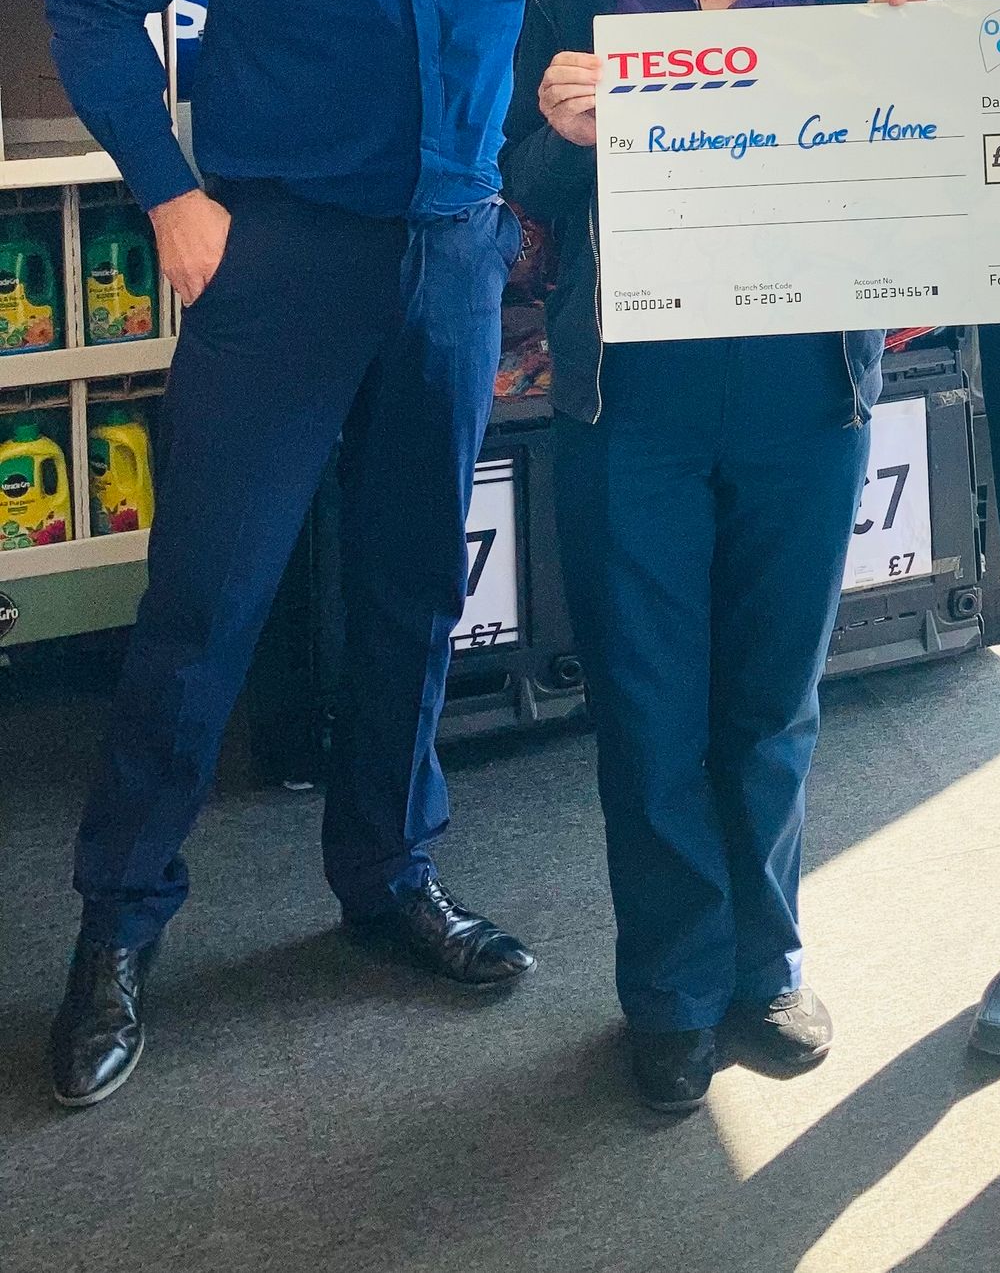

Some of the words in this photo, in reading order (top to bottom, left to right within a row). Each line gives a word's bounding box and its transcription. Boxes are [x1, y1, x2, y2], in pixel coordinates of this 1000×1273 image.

[608, 46, 758, 79] TESCO
[610, 136, 634, 151] Pay
[649, 125, 779, 160] Rutherglen
[797, 114, 849, 150] Care
[868, 104, 938, 144] Home
[734, 283, 758, 291] Branch
[759, 282, 774, 291] Sort
[774, 282, 793, 290] Code
[854, 278, 882, 286] Account
[614, 290, 640, 298] Cheque
[735, 292, 802, 306] 05-20-10
[888, 552, 916, 577] £7
[470, 621, 502, 647] £7
